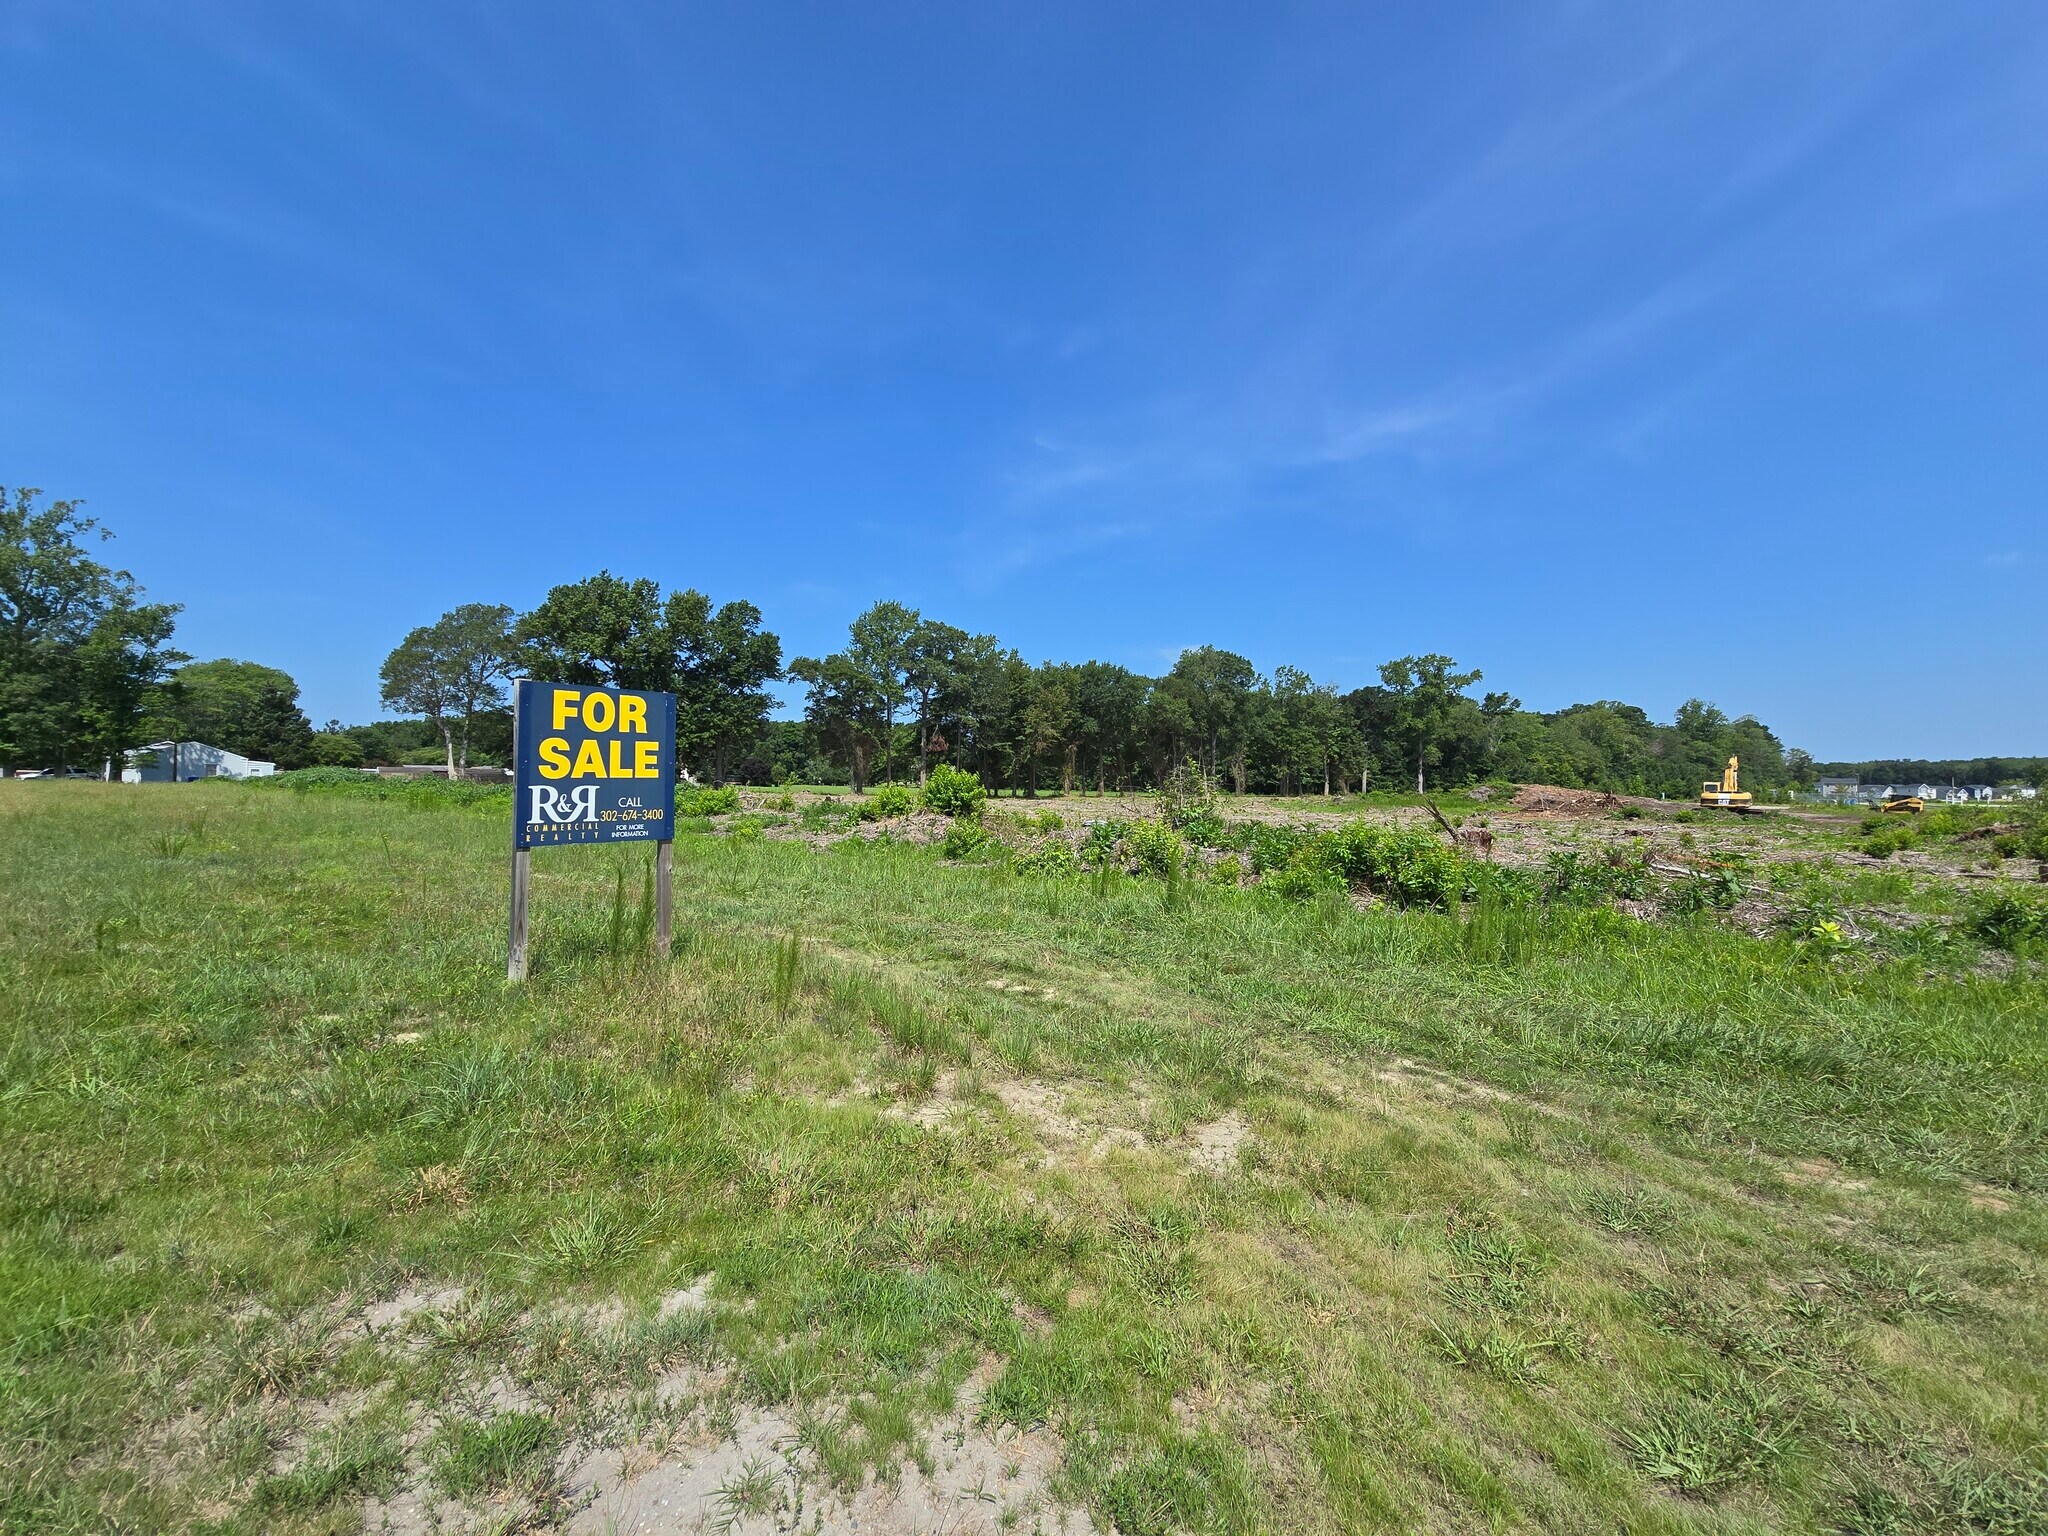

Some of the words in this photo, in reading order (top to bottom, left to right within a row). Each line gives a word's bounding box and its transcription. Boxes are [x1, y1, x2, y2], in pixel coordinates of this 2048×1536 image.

[552, 689, 648, 734] FOR
[538, 737, 660, 780] SALE
[618, 797, 643, 808] CALL
[600, 809, 664, 822] 302-674-3400
[526, 822, 599, 833] COMMERCIAL
[525, 832, 599, 842] REALTY
[611, 830, 649, 838] INFORMATION
